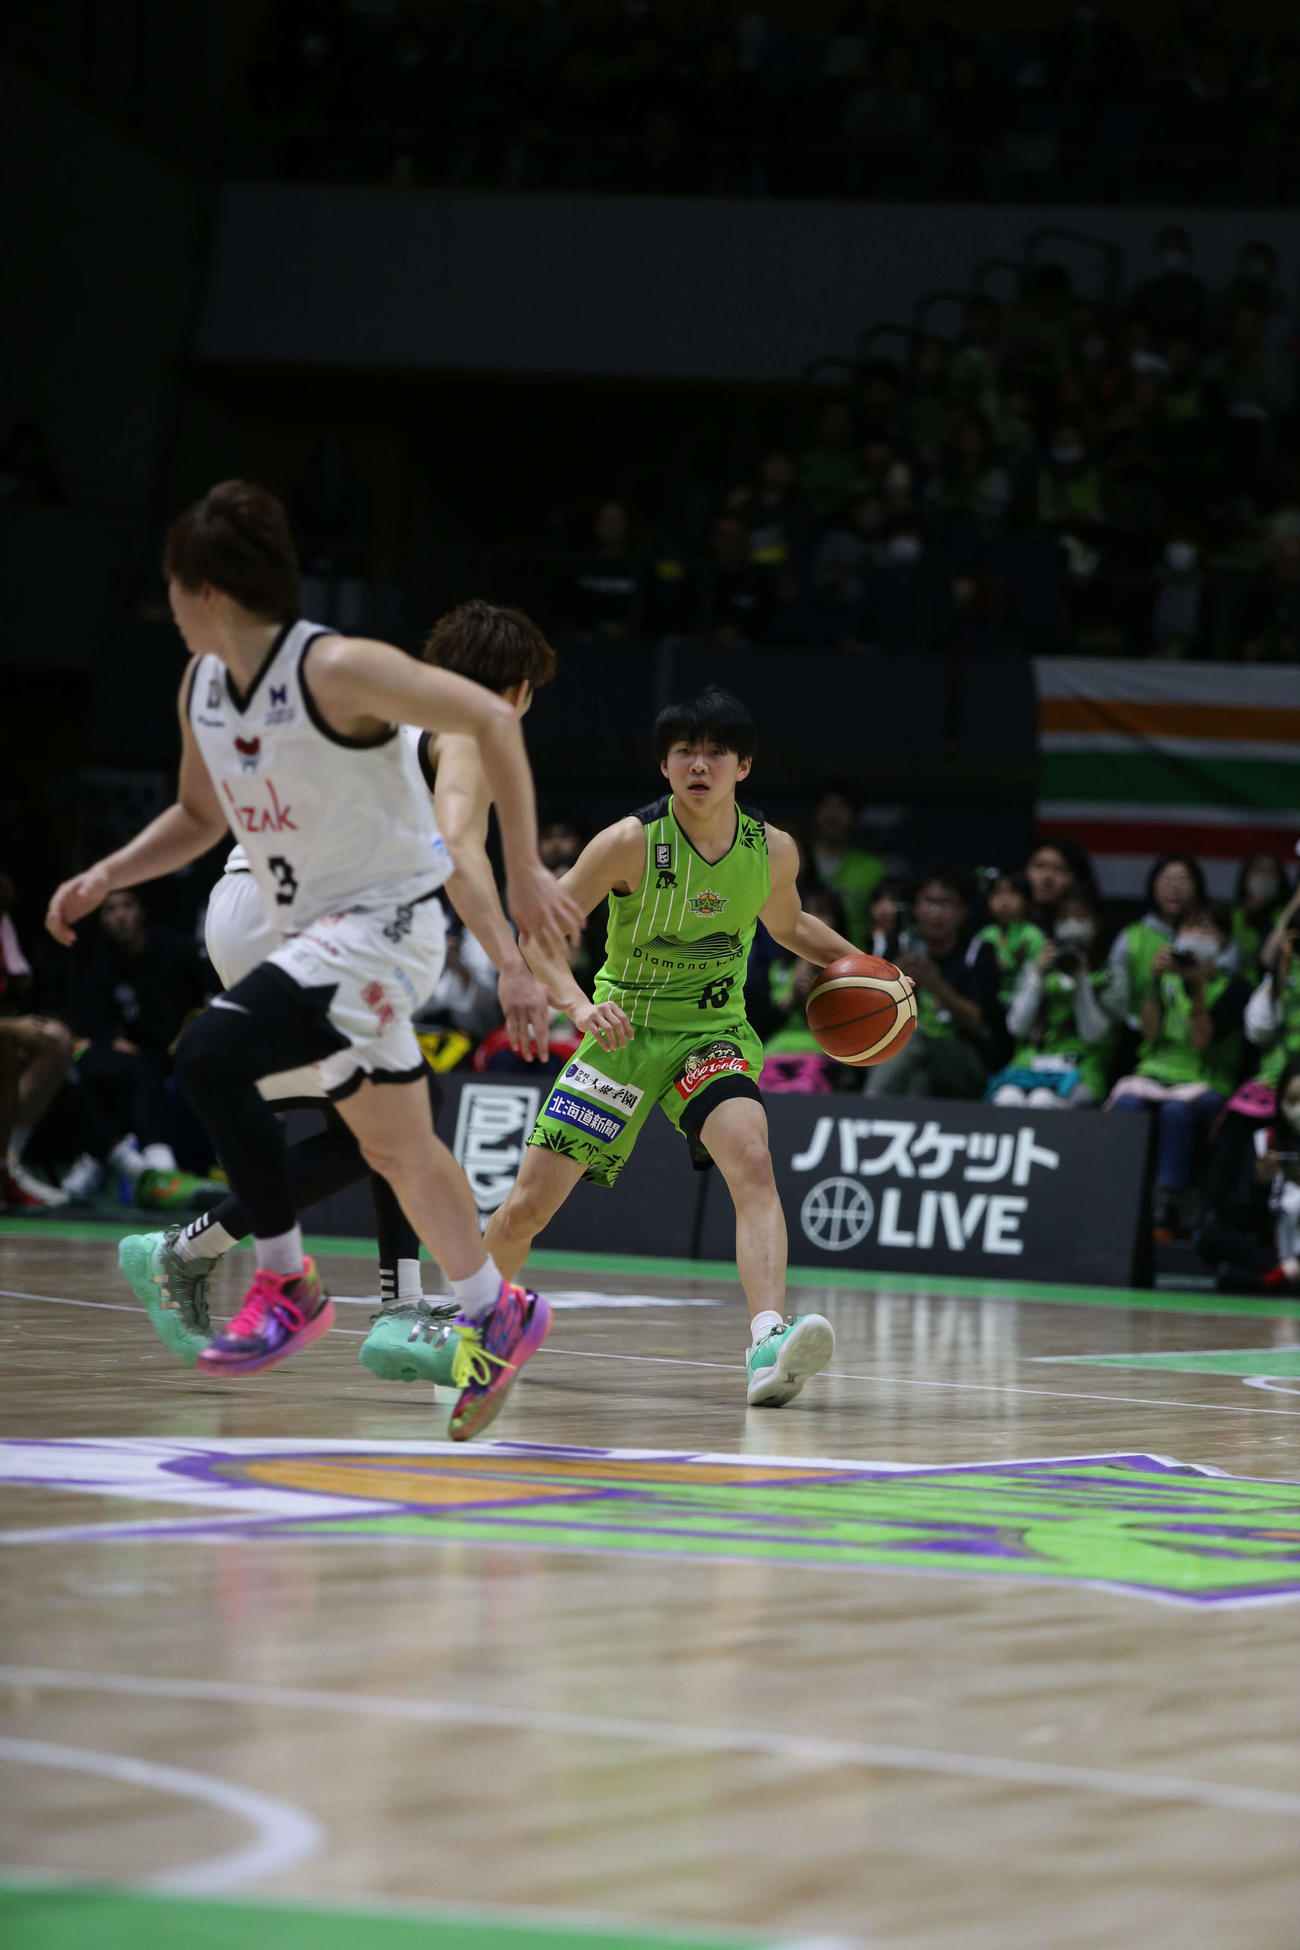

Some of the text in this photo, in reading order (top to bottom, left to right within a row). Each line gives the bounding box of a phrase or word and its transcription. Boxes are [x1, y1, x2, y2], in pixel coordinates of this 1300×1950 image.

[267, 855, 298, 906] 3
[632, 947, 707, 970] Diamond
[549, 1095, 621, 1139] 北海道新聞
[791, 1116, 1060, 1187] バスケット
[877, 1187, 1029, 1256] LIVE
